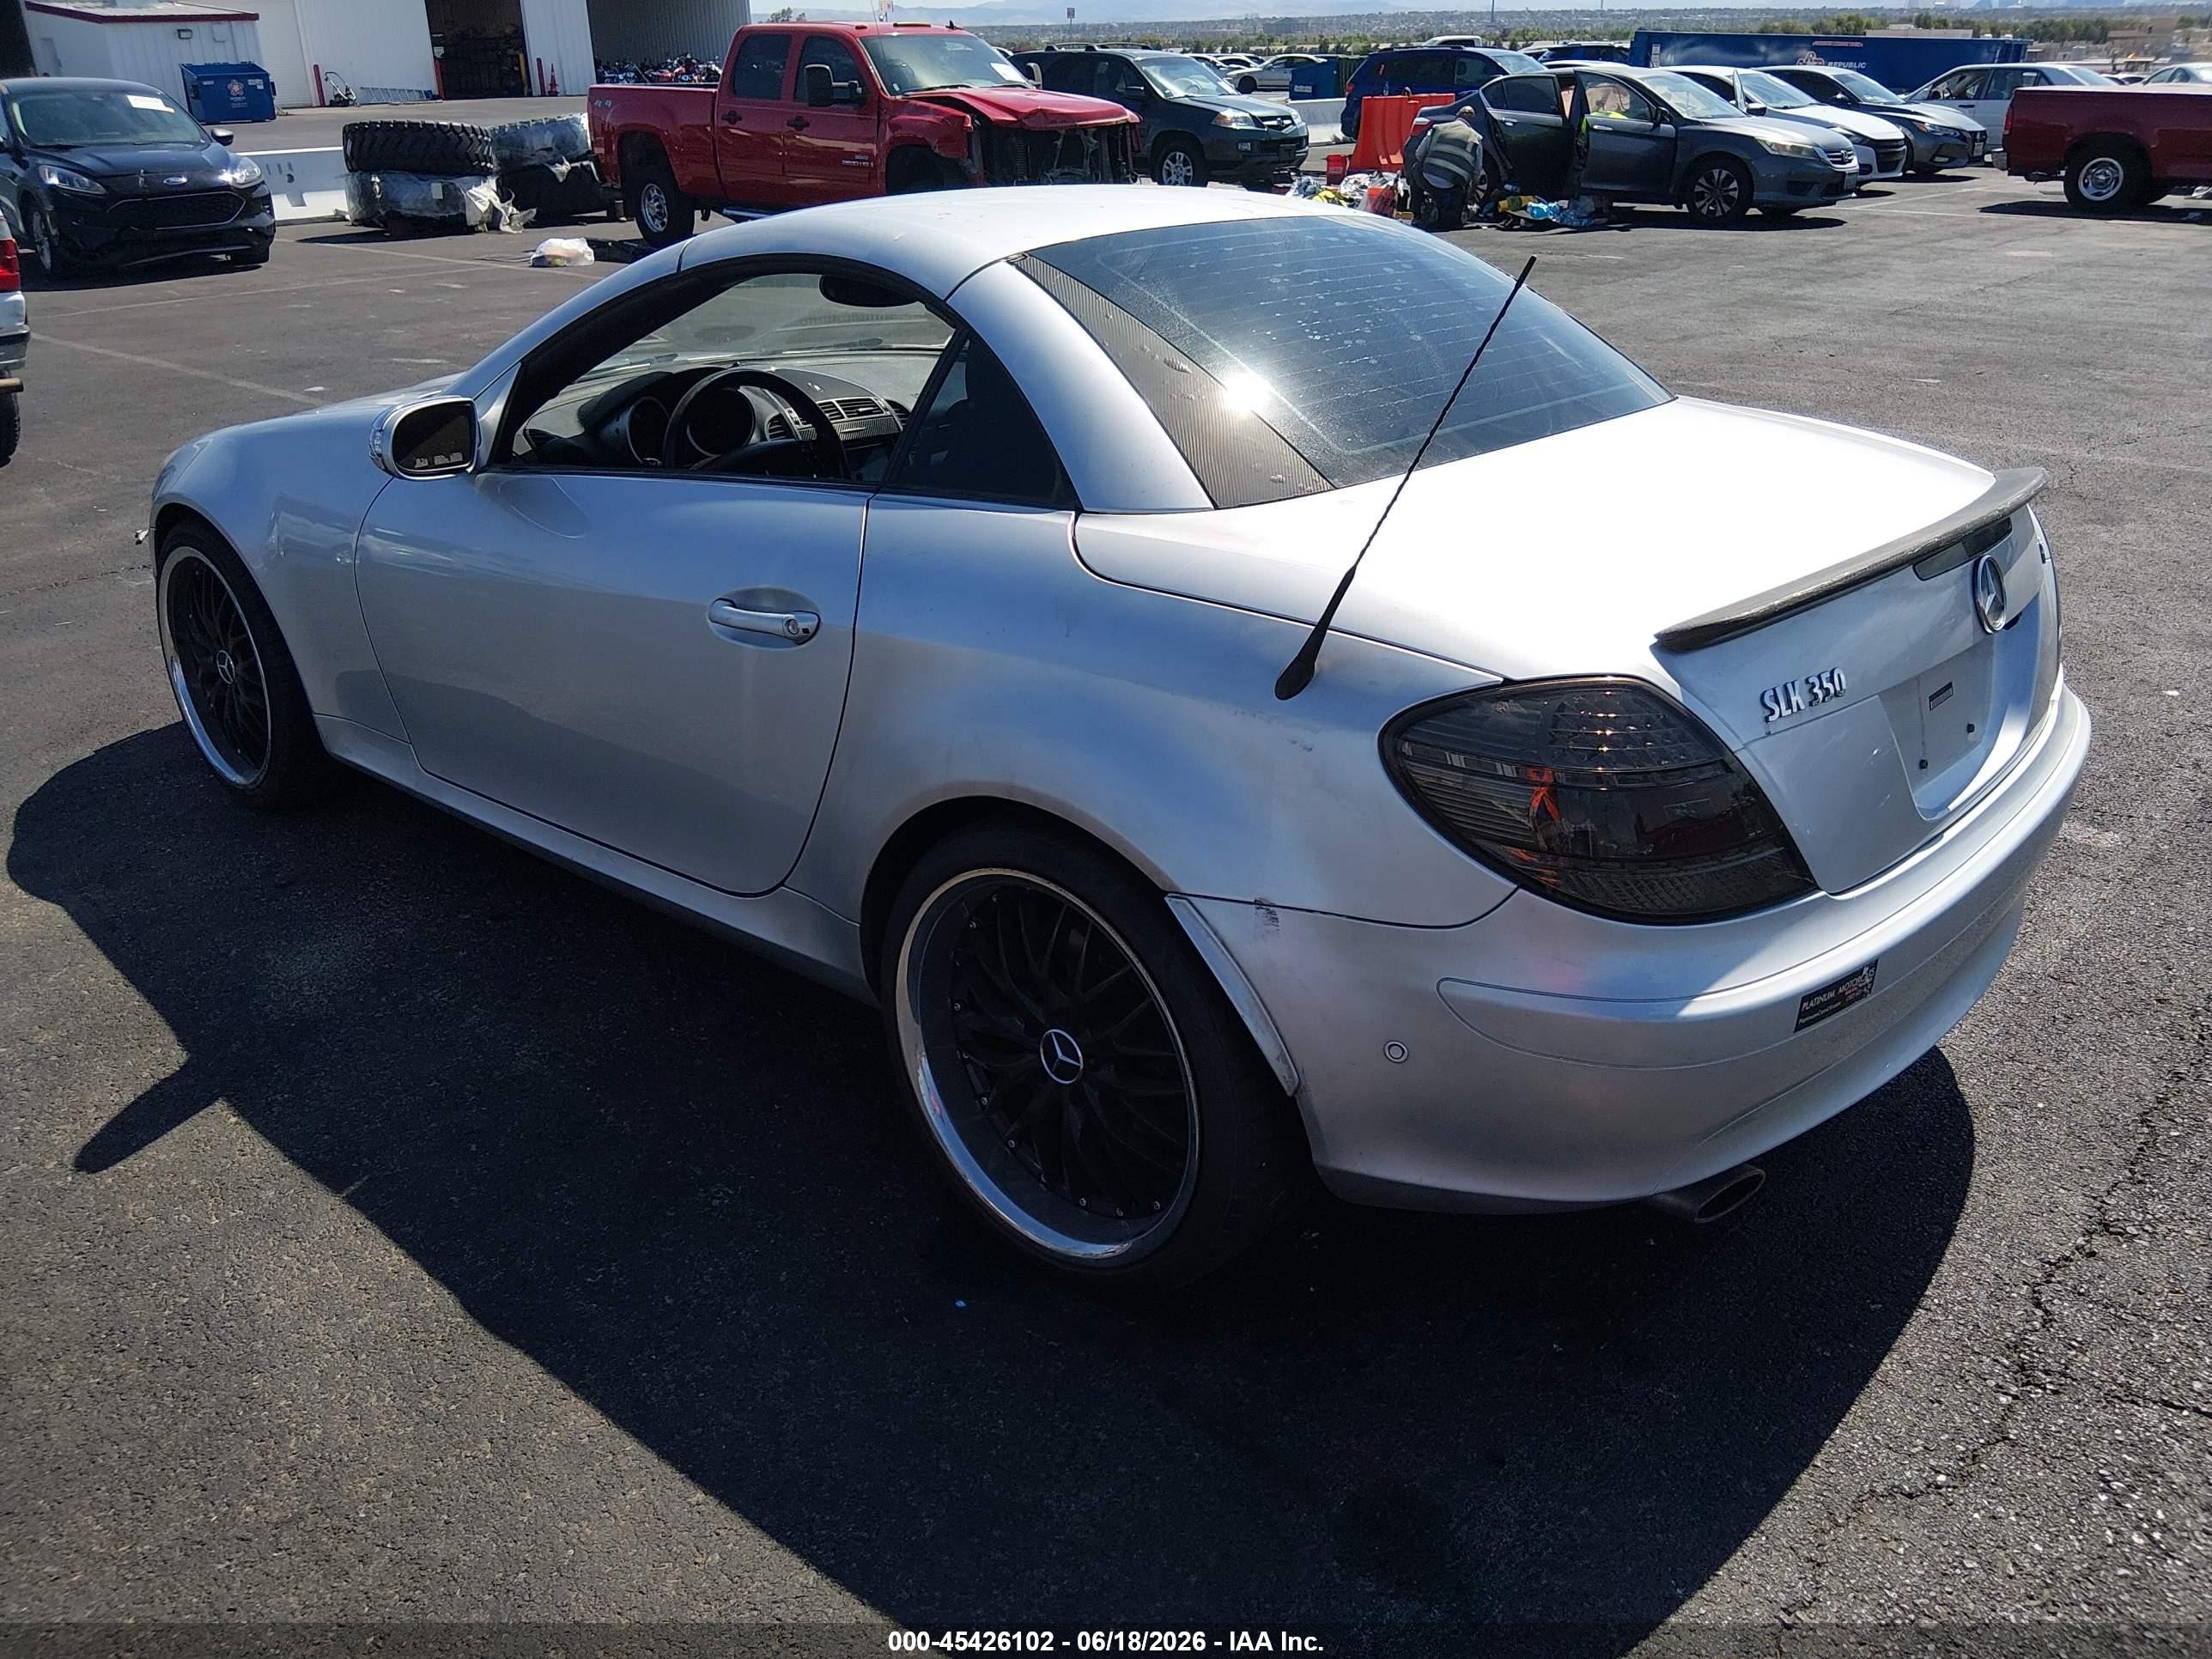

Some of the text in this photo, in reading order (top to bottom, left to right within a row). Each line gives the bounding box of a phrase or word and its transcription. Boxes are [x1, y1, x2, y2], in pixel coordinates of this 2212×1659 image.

[1761, 667, 1847, 722] SLK 350
[1802, 989, 1835, 1012] PLATINUM
